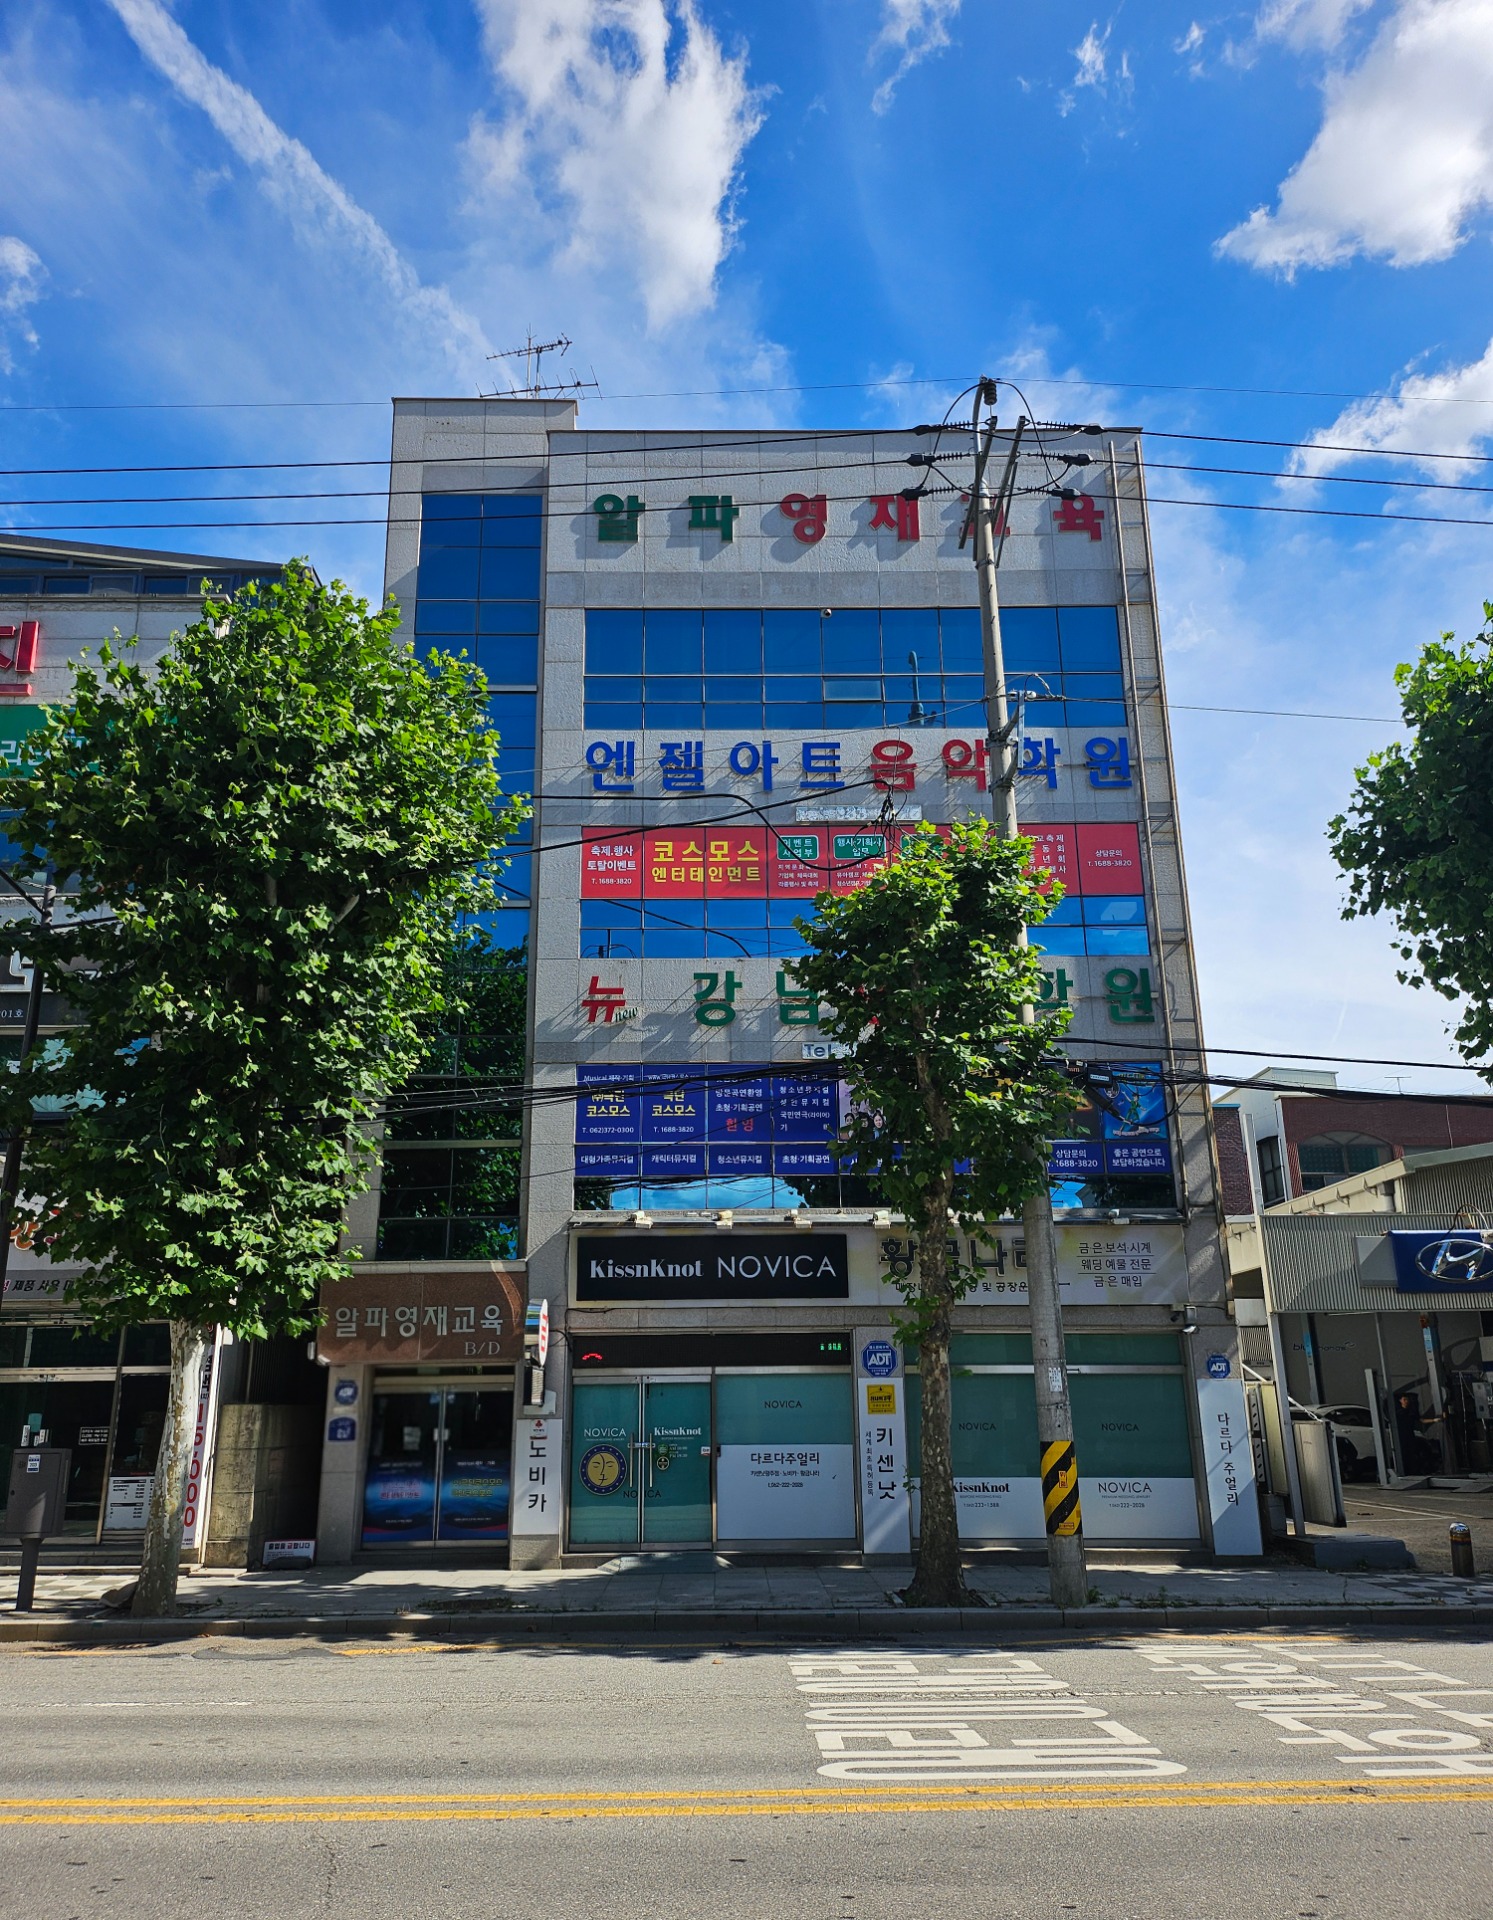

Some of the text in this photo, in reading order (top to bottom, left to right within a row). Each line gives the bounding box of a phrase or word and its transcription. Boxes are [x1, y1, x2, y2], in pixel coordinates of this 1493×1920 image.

[653, 841, 759, 862] 코스모스
[587, 861, 637, 871] 토탈이벤트
[651, 866, 761, 883] 엔터테인먼트
[581, 975, 626, 1023] 뉴
[586, 1105, 631, 1117] 코스모스
[651, 1104, 696, 1117] 코스모스
[1055, 1149, 1087, 1159] 상담문의
[1131, 1149, 1163, 1157] 공연으로
[590, 1254, 837, 1279] KissnKnot NOVICA
[1081, 1258, 1103, 1271] 웨딩
[1129, 1258, 1152, 1271] 전문
[1120, 1275, 1143, 1287] 매입
[335, 1305, 504, 1338] 알파영재교육
[868, 1352, 892, 1367] ADT
[1210, 1362, 1227, 1372] ADT
[764, 1400, 803, 1409] NOVICA
[583, 1427, 627, 1438] NOVICA
[654, 1426, 702, 1436] KissnKnot
[958, 1422, 997, 1432] NOVICA
[1101, 1422, 1139, 1432] NOVICA
[750, 1452, 820, 1466] 다르다주얼리
[528, 1440, 547, 1513] 노비카
[1098, 1481, 1153, 1494] NOVICA
[804, 1699, 1188, 1780] 어린이
